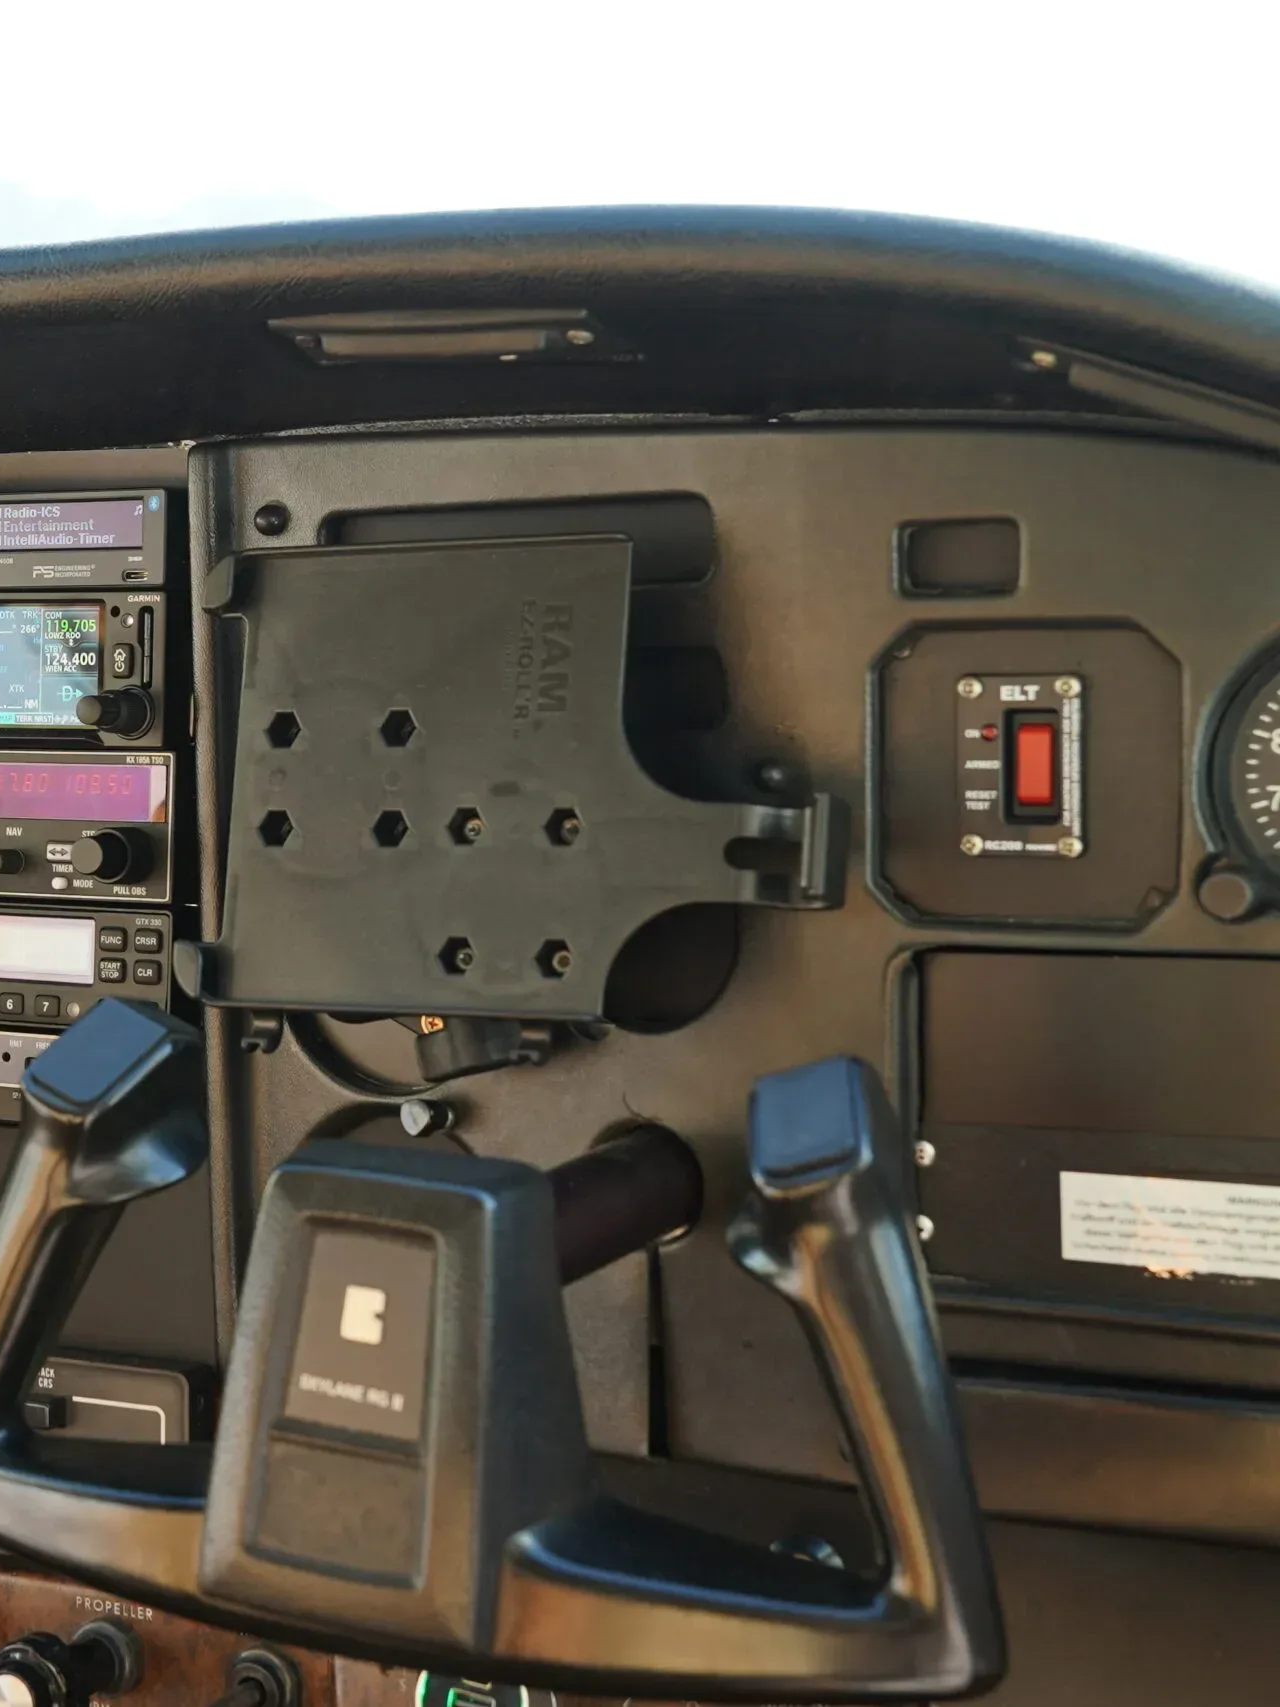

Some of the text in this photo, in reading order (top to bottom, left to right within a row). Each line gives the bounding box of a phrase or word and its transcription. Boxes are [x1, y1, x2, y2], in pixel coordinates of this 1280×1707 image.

[4, 507, 61, 518] Radio-ICS
[4, 519, 94, 533] Entertainment
[4, 533, 116, 546] IntelliAudio-Timer
[0, 611, 15, 620] DTK
[45, 611, 62, 619] COM
[46, 620, 96, 632] 119.705
[45, 645, 63, 653] STBY
[45, 653, 96, 666] 124.400
[45, 665, 62, 673] WIEN
[8, 684, 24, 693] XTK
[1000, 685, 1040, 701] ELT
[966, 801, 991, 810] TEST
[6, 827, 22, 836] NAV
[52, 864, 73, 872] TIMER
[73, 879, 93, 888] MODE
[113, 886, 146, 895] PULL OBS
[135, 917, 162, 926] GTX 330
[100, 935, 122, 944] FUNC
[135, 937, 157, 946] CRSR
[100, 962, 121, 970] START
[101, 971, 119, 979] STOP
[137, 968, 153, 977] CLR
[38, 1377, 53, 1389] CRS
[75, 1595, 154, 1621] PROPELLER
